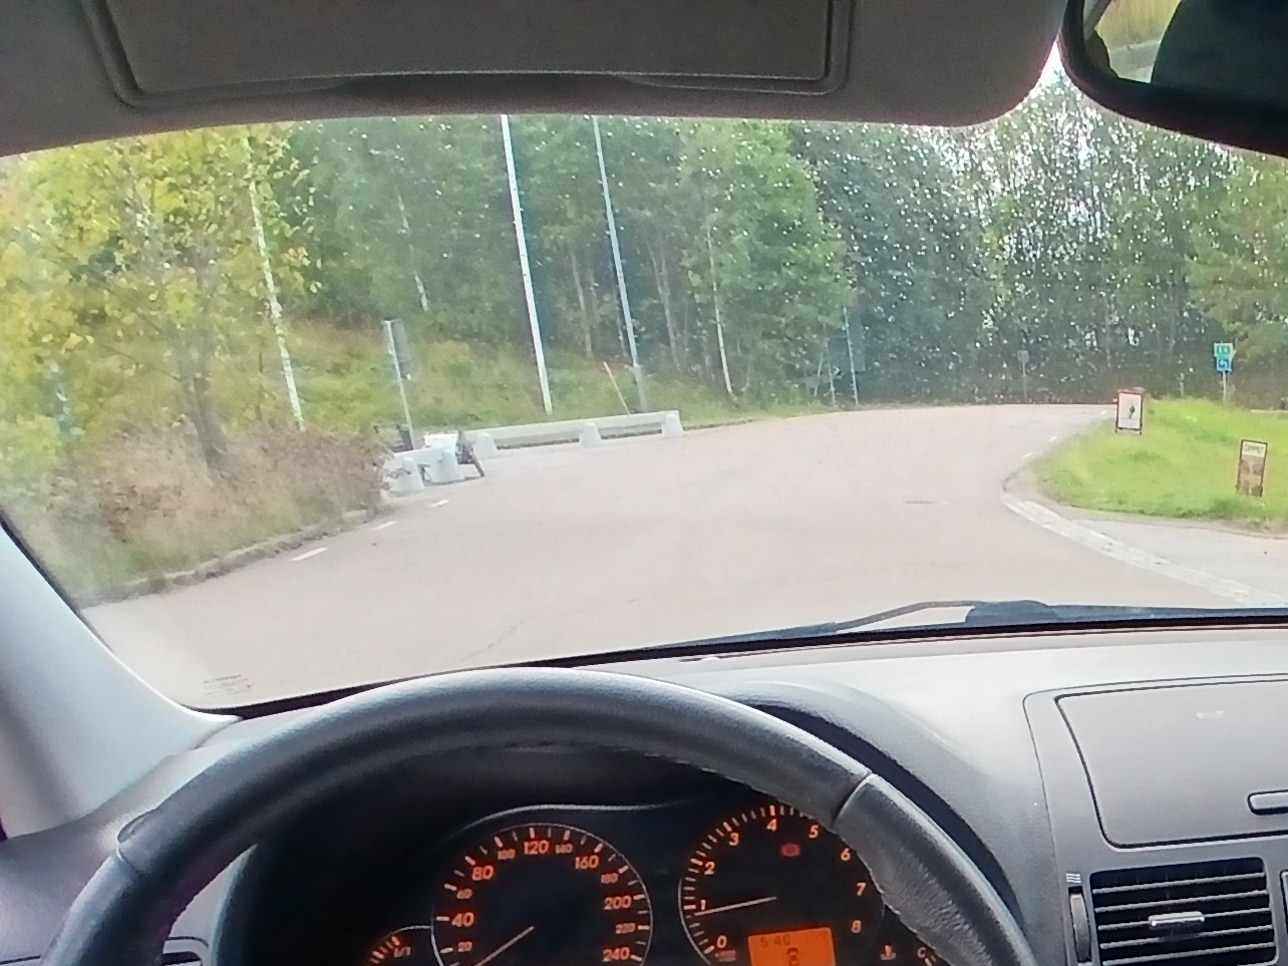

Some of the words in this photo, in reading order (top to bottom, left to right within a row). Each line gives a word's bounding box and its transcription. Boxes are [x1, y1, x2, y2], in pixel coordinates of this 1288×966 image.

[767, 819, 778, 832] 4
[809, 825, 819, 839] 5
[729, 833, 740, 847] 3
[524, 840, 548, 855] 120
[840, 848, 851, 861] 6
[575, 856, 599, 870] 160
[704, 862, 716, 876] 2
[471, 865, 494, 881] 80
[857, 882, 867, 896] 7
[604, 896, 631, 910] 200
[451, 912, 474, 928] 40
[852, 920, 861, 934] 8
[716, 935, 728, 949] 0
[603, 947, 631, 962] 240
